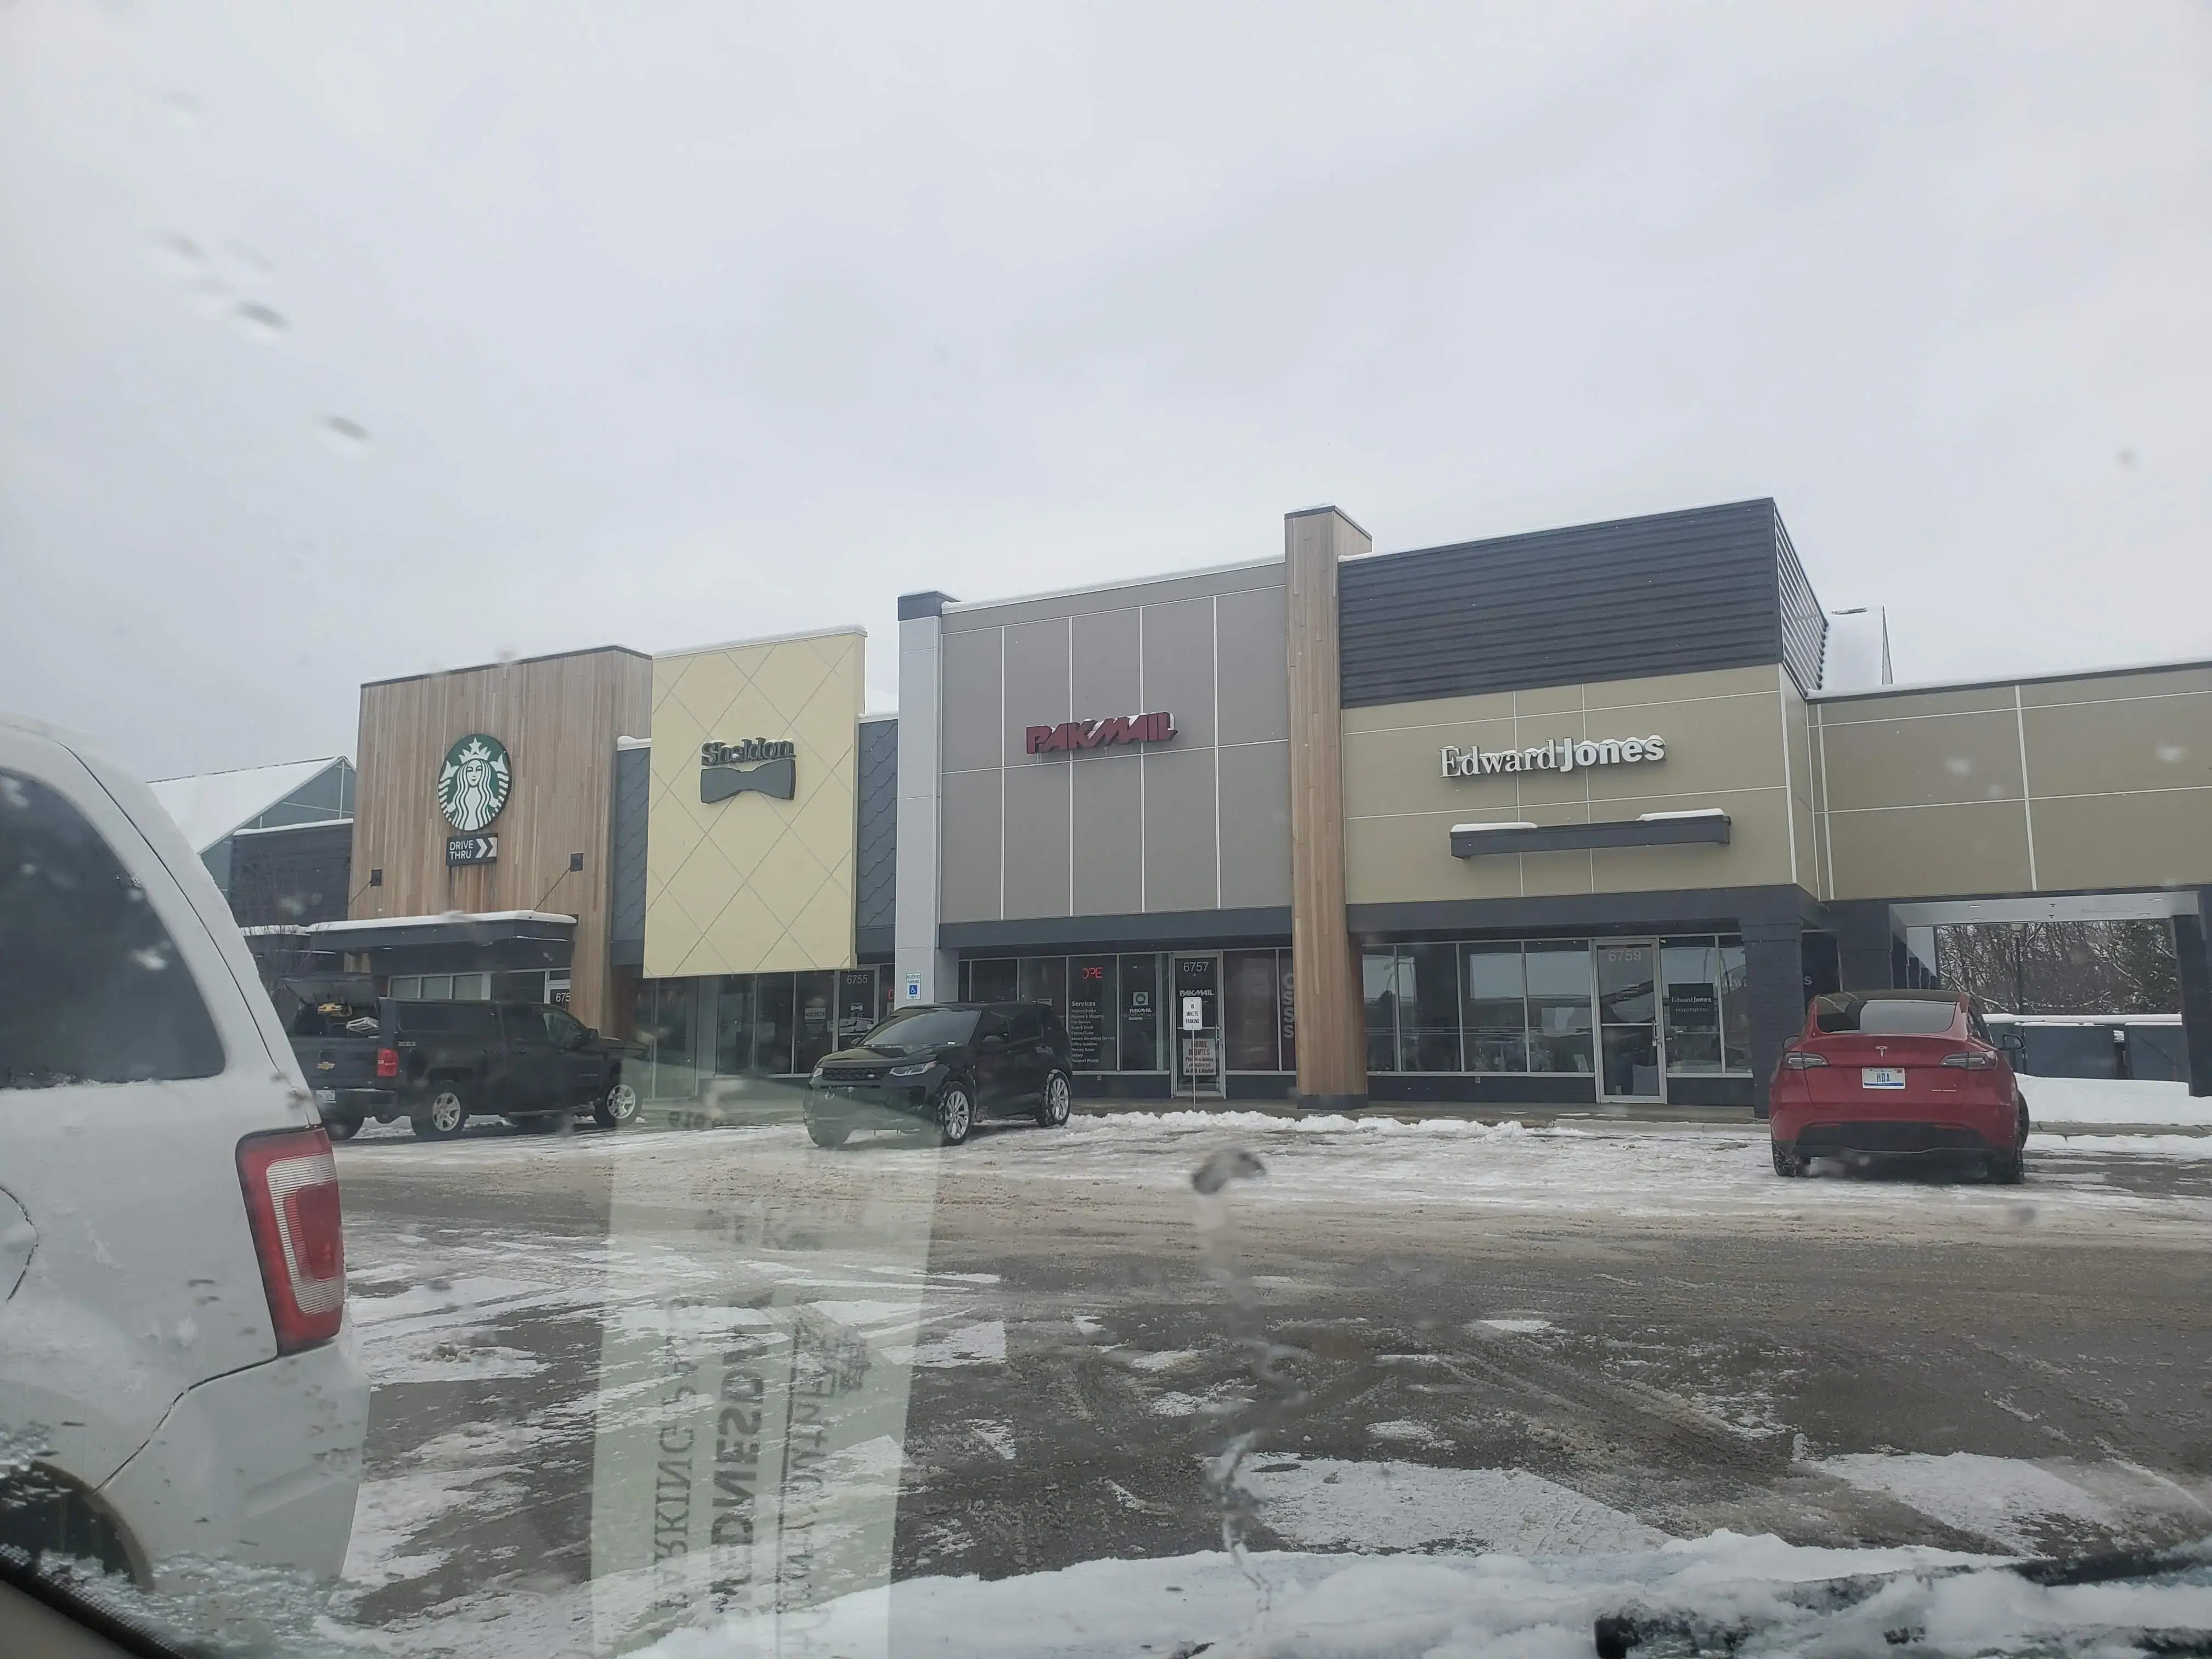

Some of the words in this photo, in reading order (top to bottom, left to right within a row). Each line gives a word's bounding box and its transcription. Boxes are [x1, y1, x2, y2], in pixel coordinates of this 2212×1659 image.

[702, 737, 795, 766] Sheldon
[450, 840, 473, 851] DRIVE
[450, 850, 472, 860] THRU
[1609, 949, 1641, 961] 6759
[1183, 962, 1209, 972] 6757
[847, 974, 868, 984] 6755
[556, 992, 571, 1002] 675
